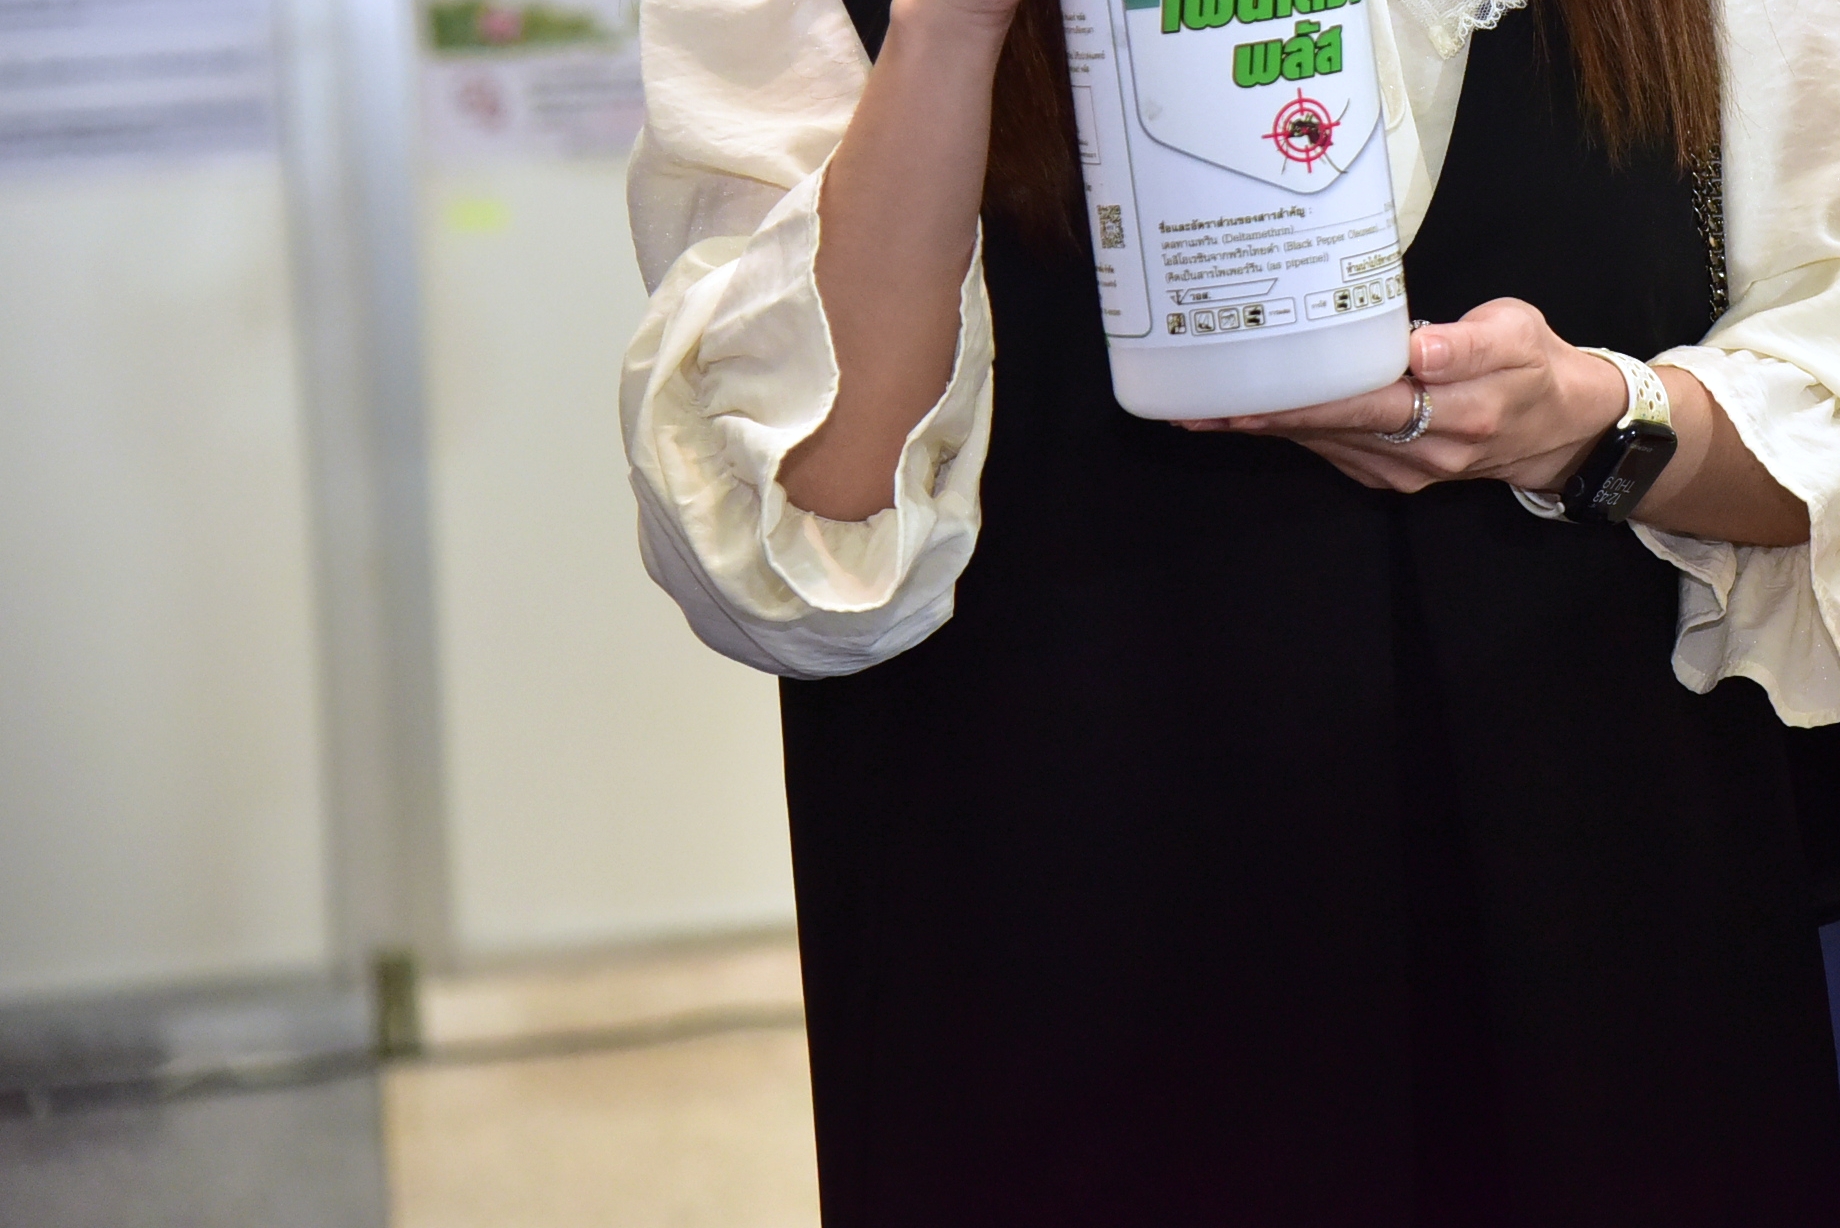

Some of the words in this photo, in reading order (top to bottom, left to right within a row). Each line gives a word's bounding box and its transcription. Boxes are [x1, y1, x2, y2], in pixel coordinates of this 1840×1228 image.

[1232, 19, 1343, 89] พลัส
[1602, 476, 1614, 489] 9
[1610, 477, 1635, 493] THU
[1592, 489, 1622, 506] 12:43
